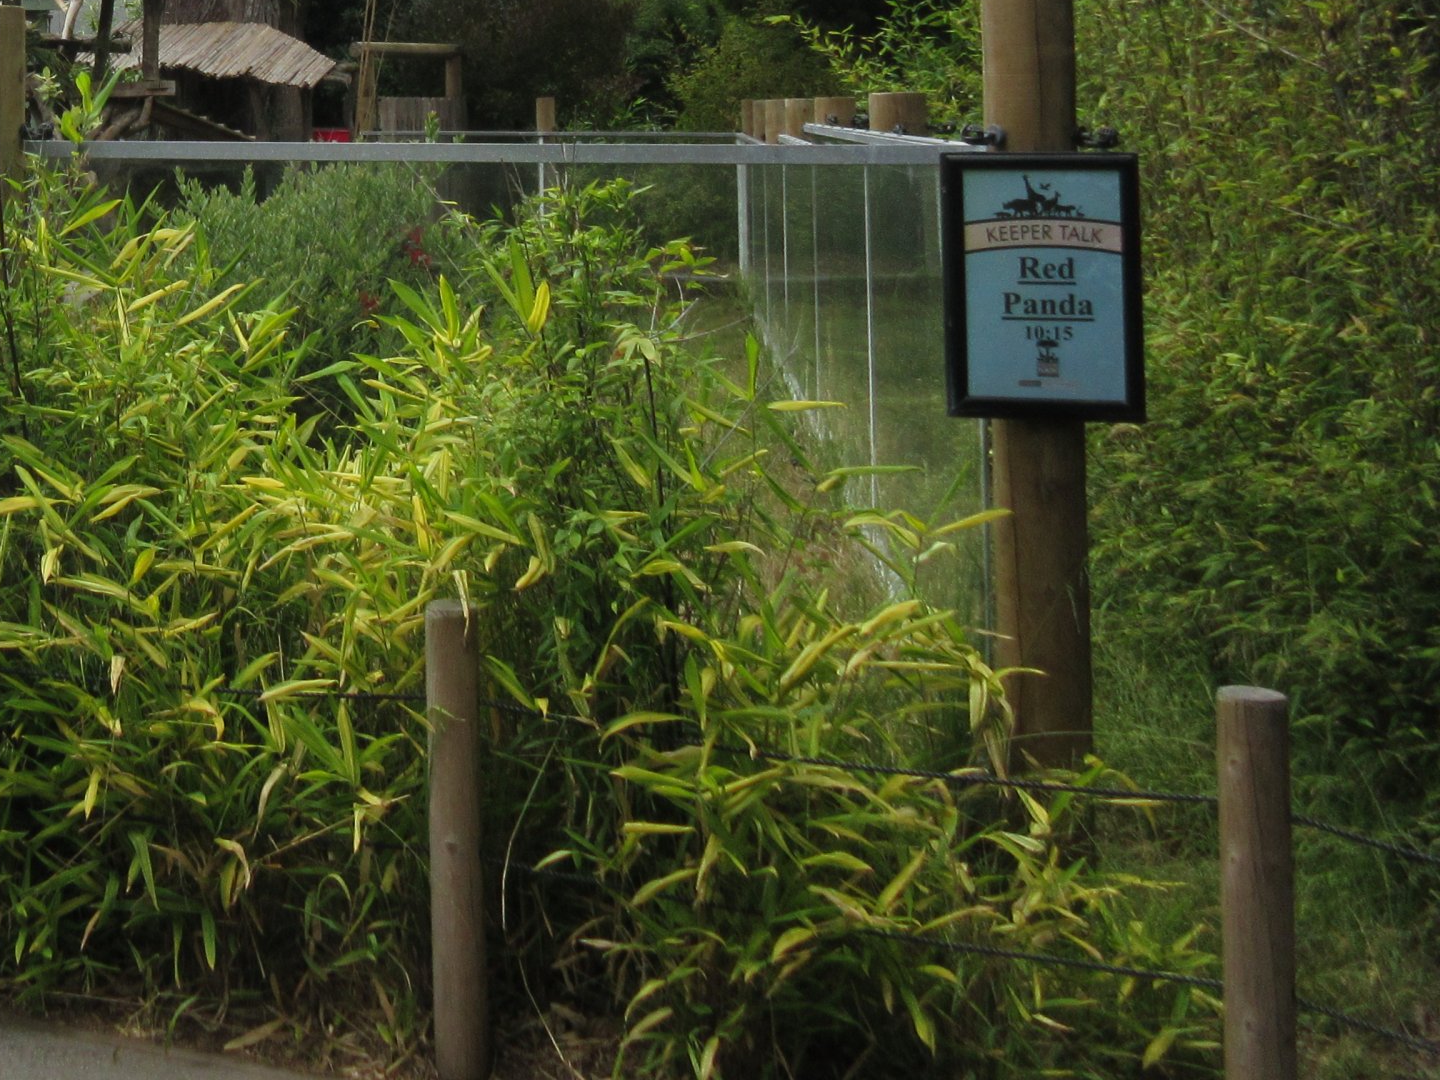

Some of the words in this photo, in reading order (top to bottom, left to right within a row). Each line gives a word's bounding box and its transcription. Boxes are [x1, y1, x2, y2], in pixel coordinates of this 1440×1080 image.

[987, 224, 1053, 243] KEEPER
[1060, 224, 1104, 243] TALK
[1018, 256, 1075, 280] Red
[1003, 292, 1093, 316] Panda
[1026, 325, 1073, 341] 10:15
